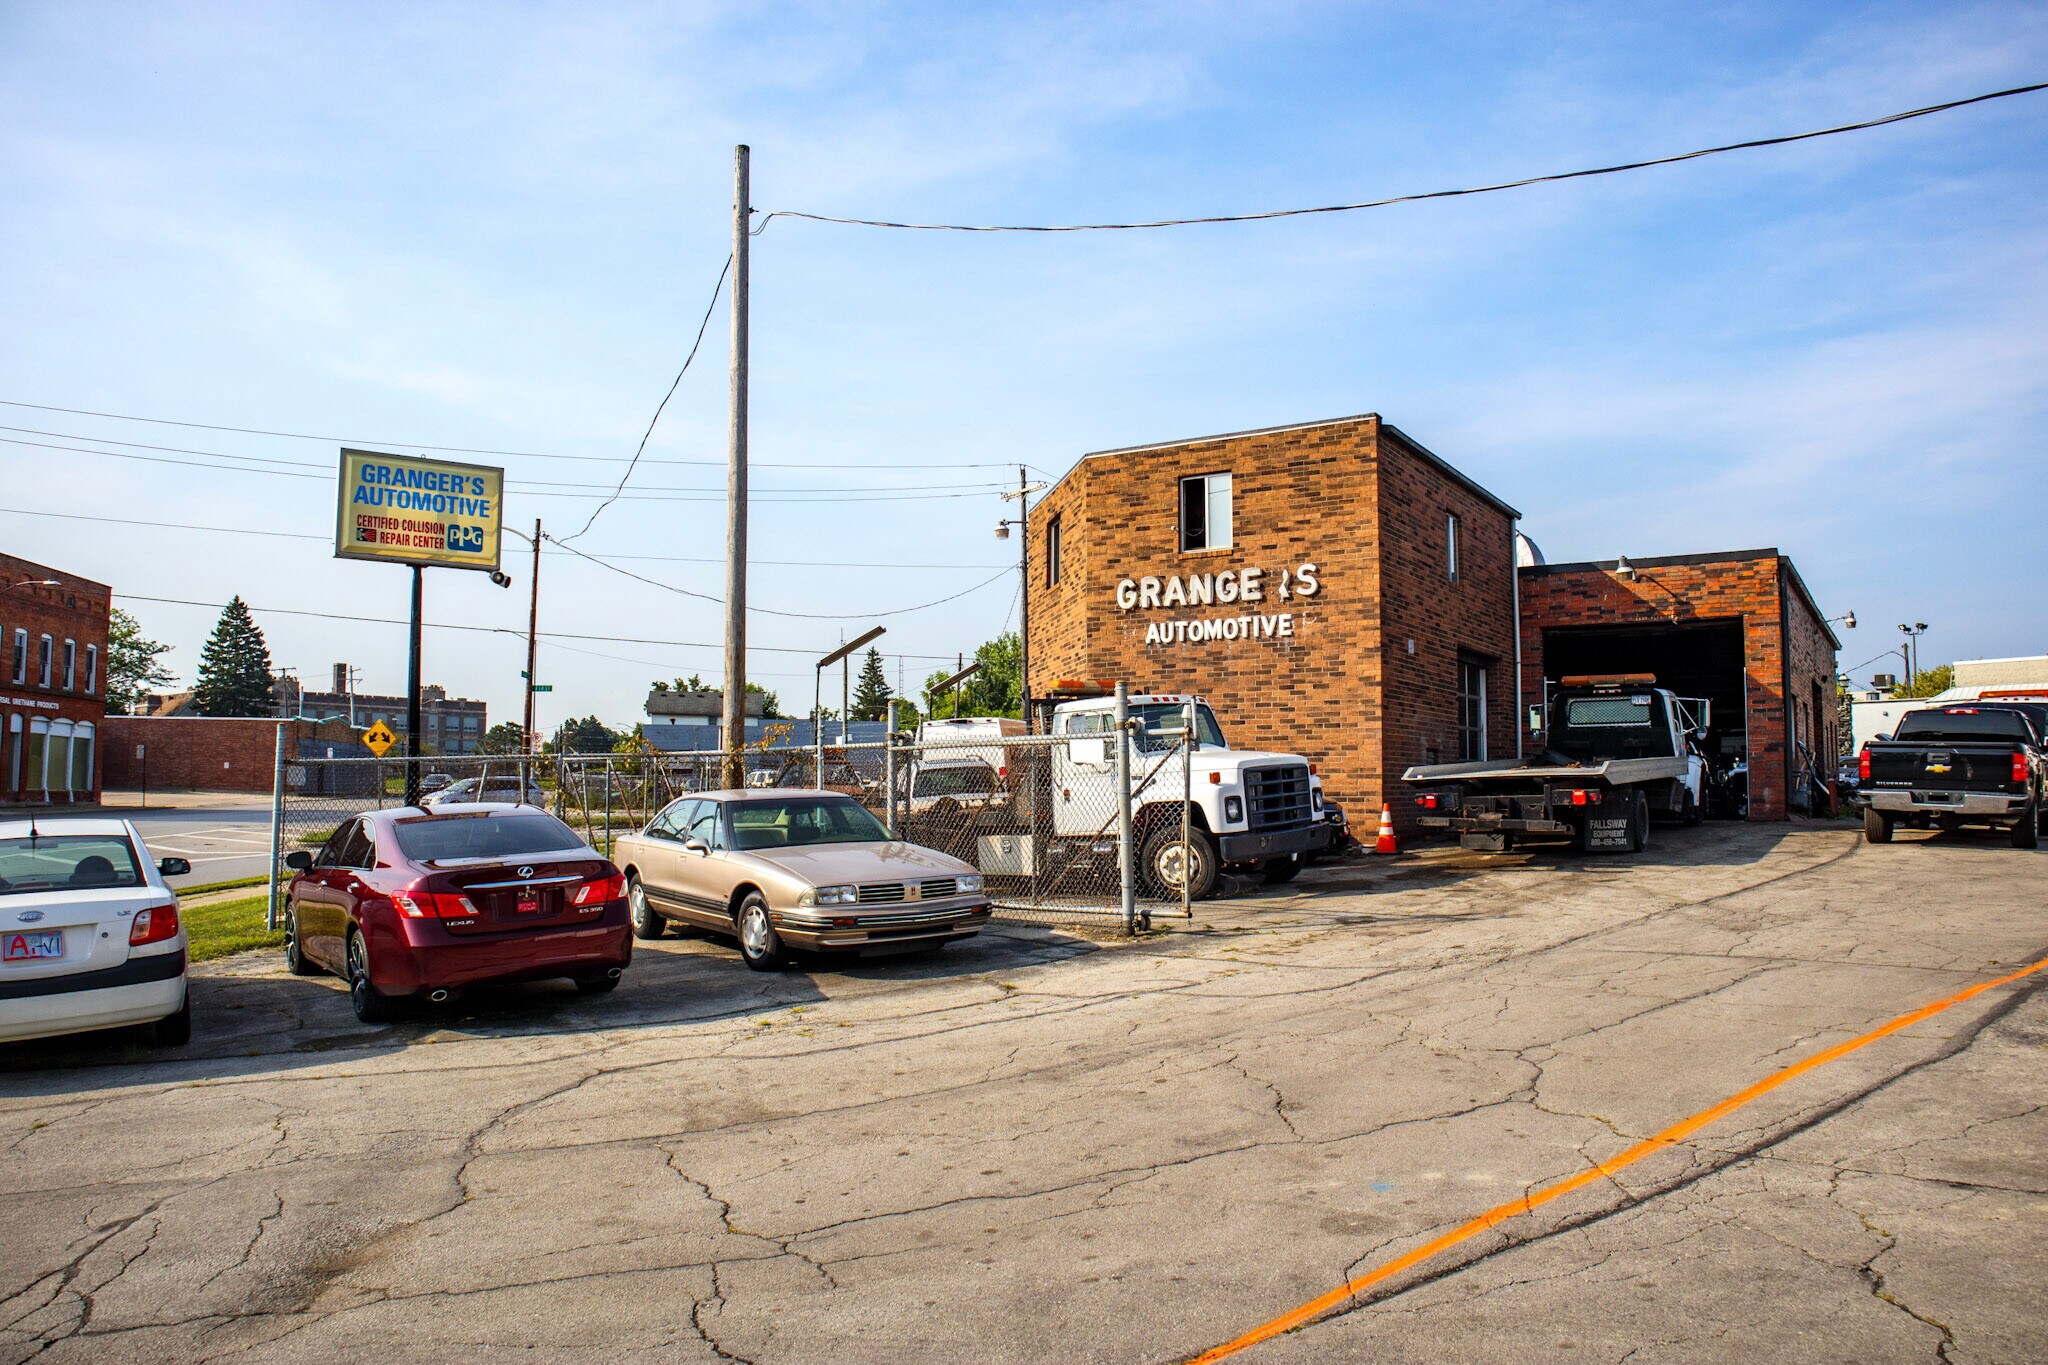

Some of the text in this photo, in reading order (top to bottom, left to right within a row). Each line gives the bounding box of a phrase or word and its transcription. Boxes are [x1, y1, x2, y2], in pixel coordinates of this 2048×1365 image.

[361, 464, 485, 495] GRANGER'S
[353, 485, 491, 518] AUTOMOTIVE
[356, 514, 445, 535] CERTIFIED COLLISION
[380, 532, 445, 549] REPAIR CENTER
[449, 526, 482, 547] PPG
[1145, 613, 1294, 644] AUTOMOTIVE
[36, 700, 60, 710] PRODUCTS
[1590, 819, 1628, 829] FALLSWAY
[1593, 829, 1625, 838] EQUIPMENT
